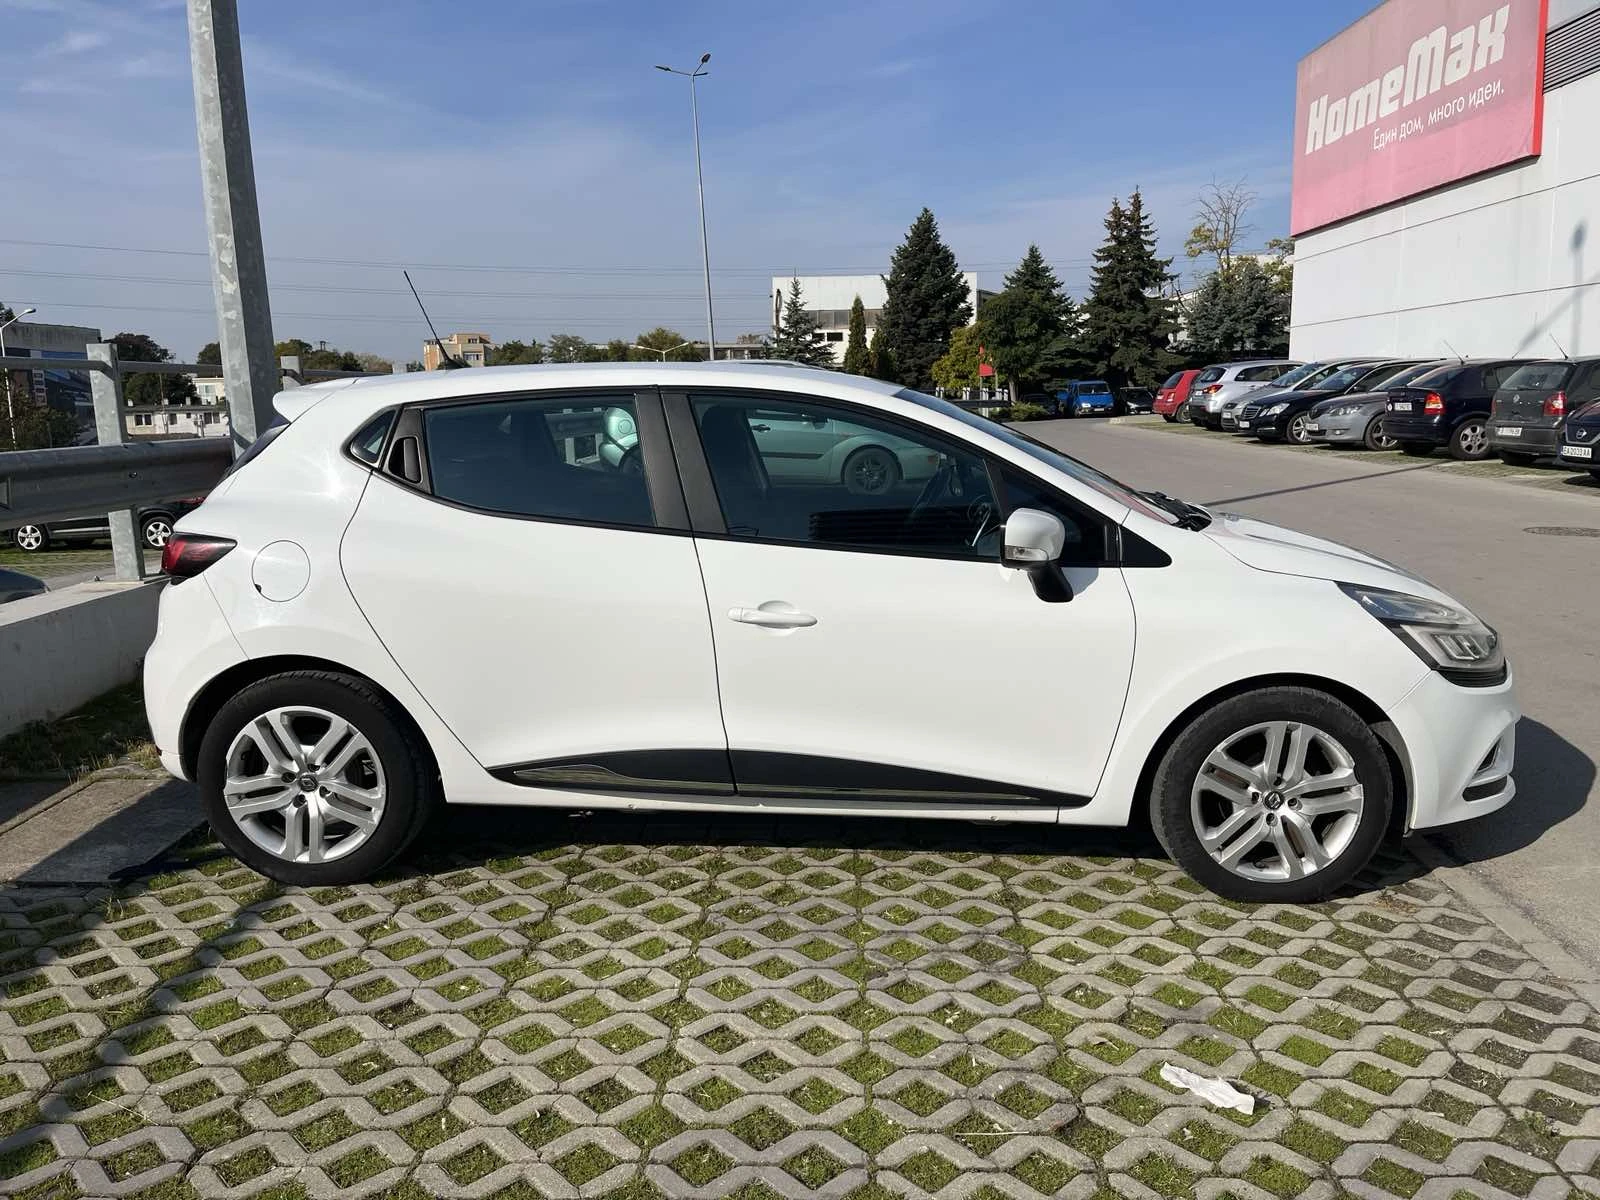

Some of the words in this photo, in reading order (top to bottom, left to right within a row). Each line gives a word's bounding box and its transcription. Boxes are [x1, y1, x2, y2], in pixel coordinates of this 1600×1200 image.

[1305, 4, 1509, 155] HomeMax
[1373, 128, 1397, 150] Един
[1400, 117, 1424, 141] дом,
[1428, 96, 1465, 125] много
[1468, 79, 1505, 107] идеи.
